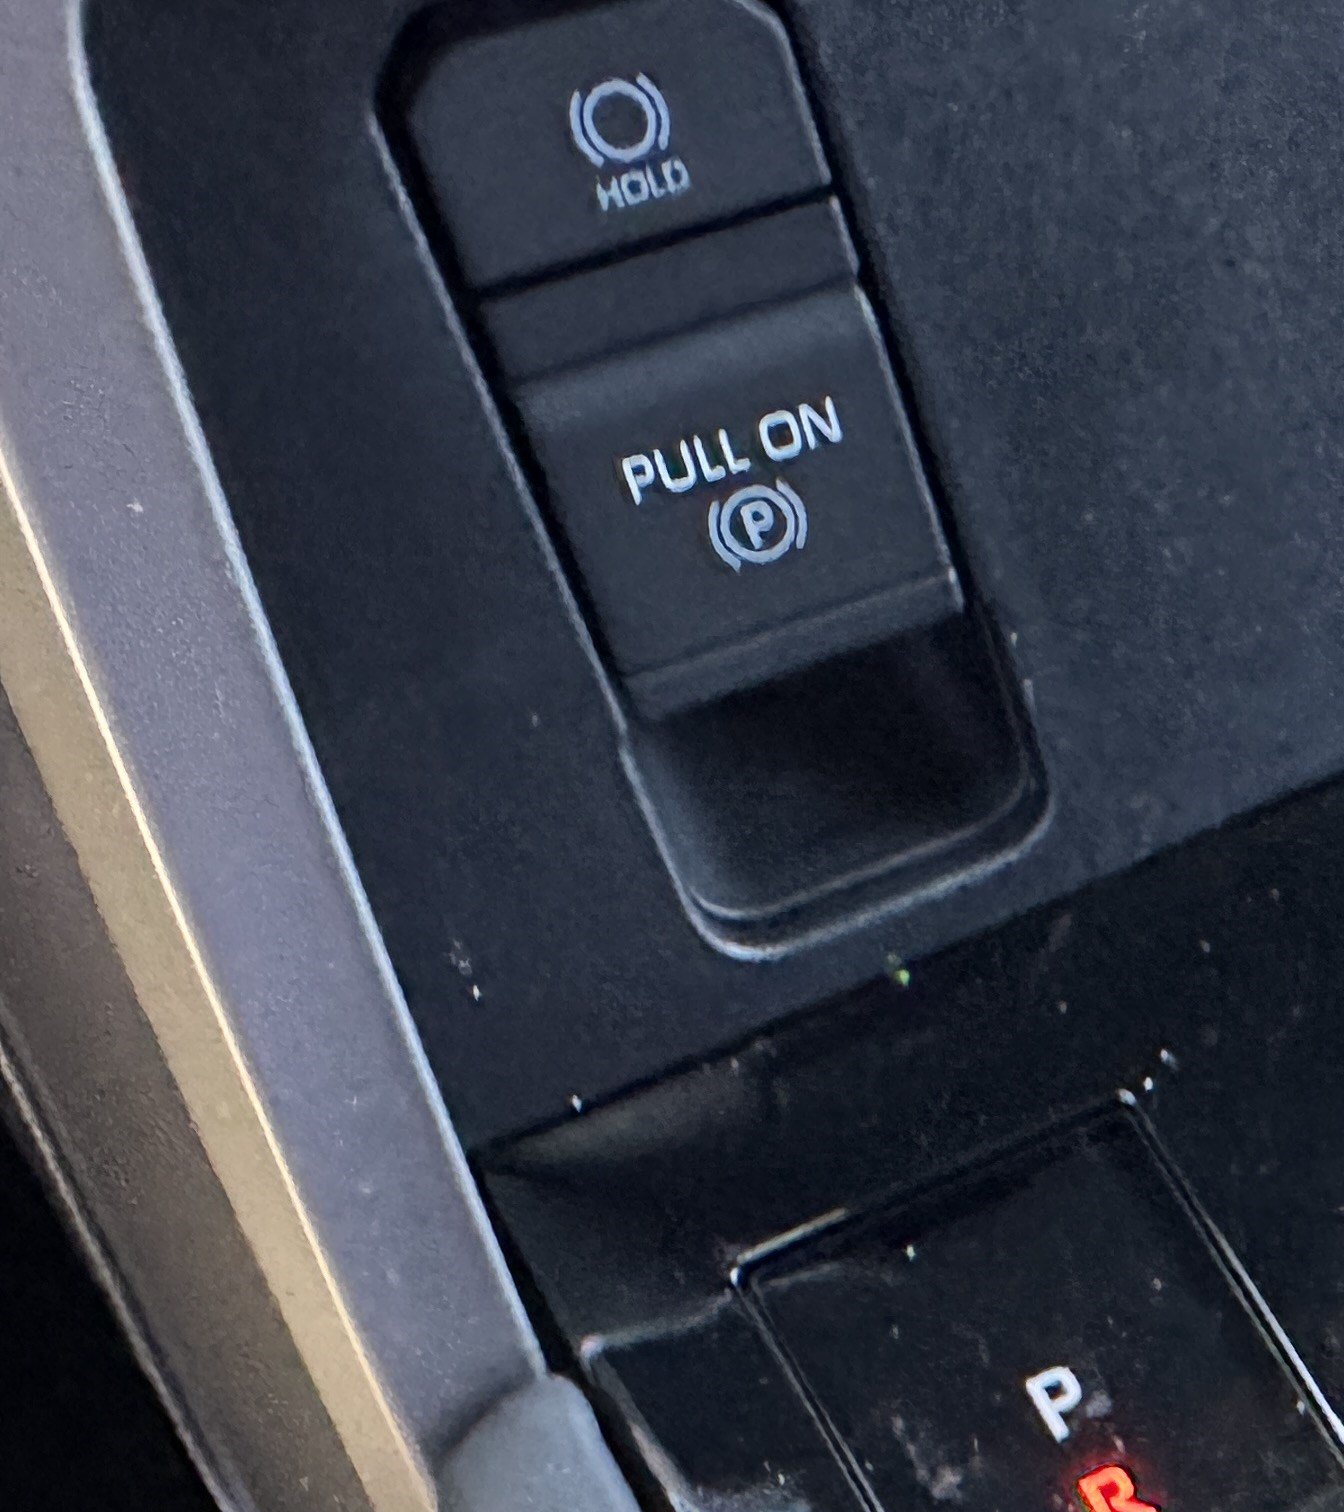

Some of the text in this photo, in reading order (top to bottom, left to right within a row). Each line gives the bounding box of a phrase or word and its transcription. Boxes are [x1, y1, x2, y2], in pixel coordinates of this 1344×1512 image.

[597, 159, 690, 211] HOLD
[620, 395, 844, 506] PULL ON
[1025, 1365, 1083, 1443] P
